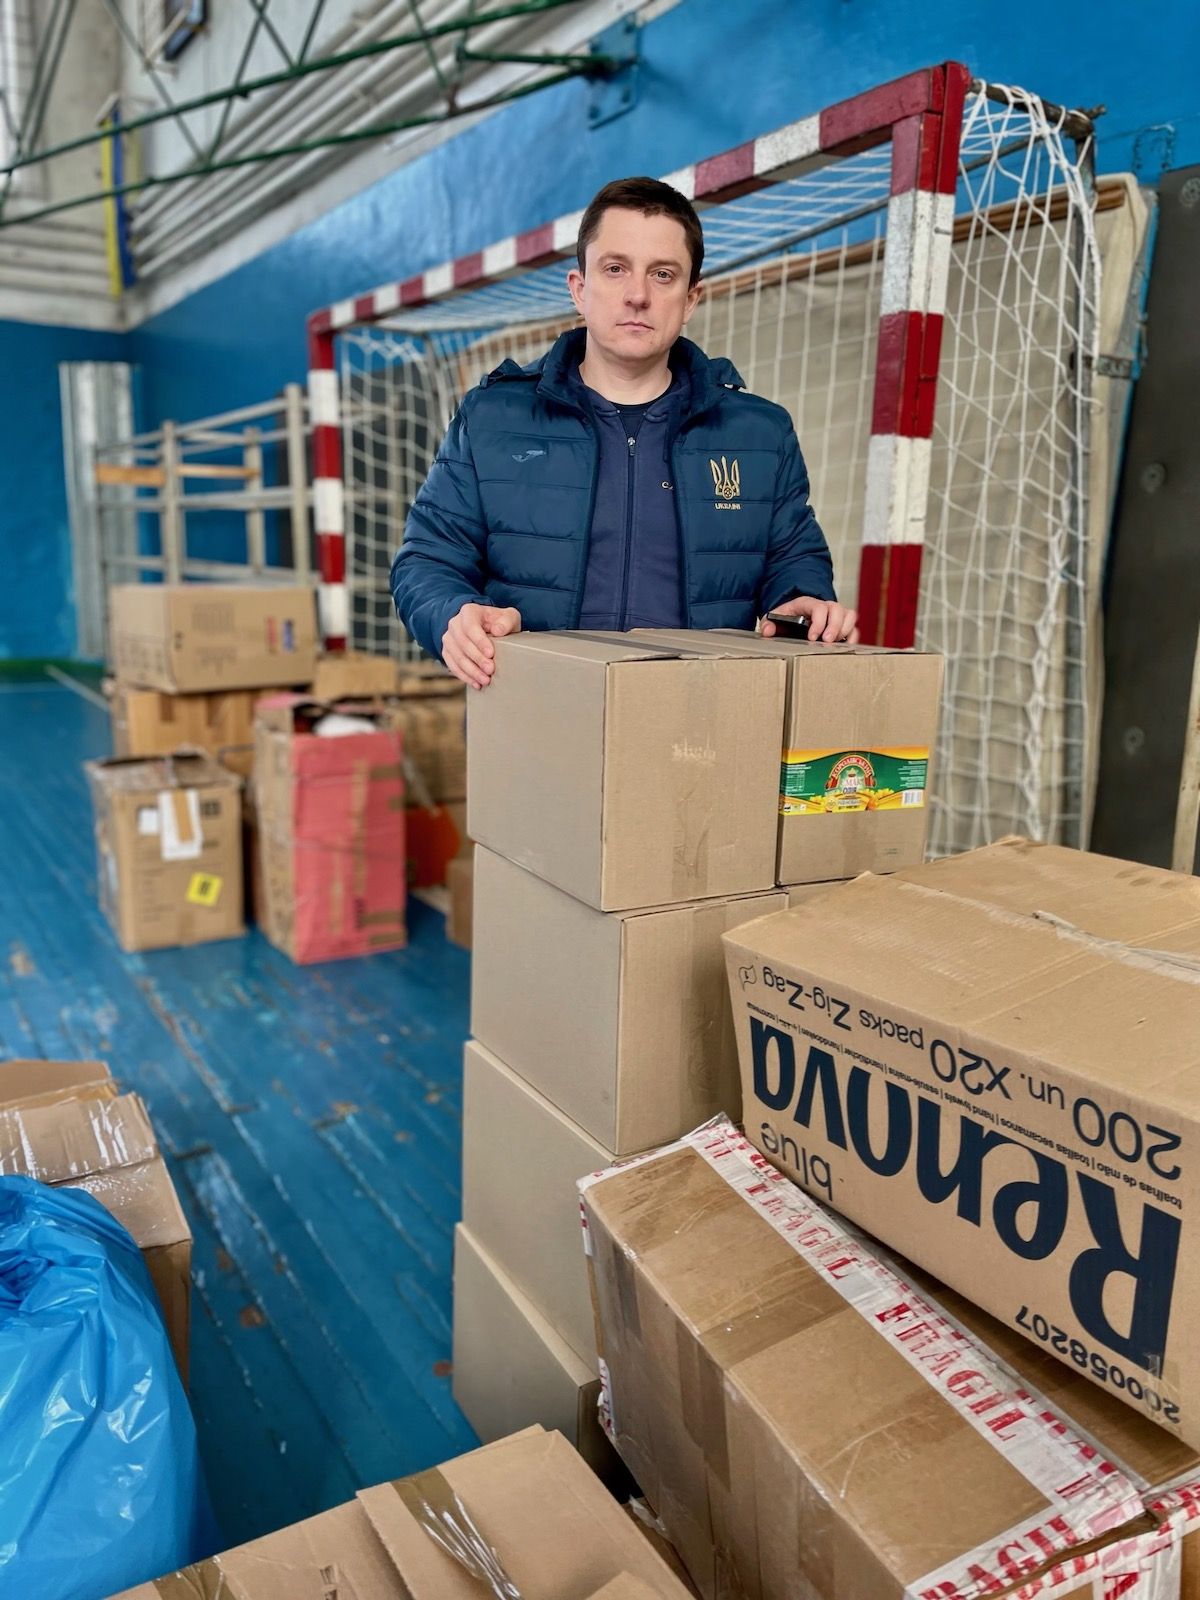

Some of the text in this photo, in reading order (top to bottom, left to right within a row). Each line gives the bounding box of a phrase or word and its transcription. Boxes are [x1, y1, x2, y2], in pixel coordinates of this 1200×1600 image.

[763, 967, 852, 1031] Zig-Zag
[859, 1008, 924, 1052] packs
[972, 1104, 994, 1123] hand
[1020, 1073, 1065, 1110] un.
[760, 1123, 833, 1201] blue
[1073, 1096, 1182, 1181] 200
[749, 1016, 1182, 1378] Renova
[1096, 1161, 1120, 1180] mão
[1122, 1173, 1136, 1189] de
[1139, 1180, 1182, 1209] toalhas
[875, 1302, 1028, 1441] FRAGIL
[1015, 1305, 1181, 1424] 200058207
